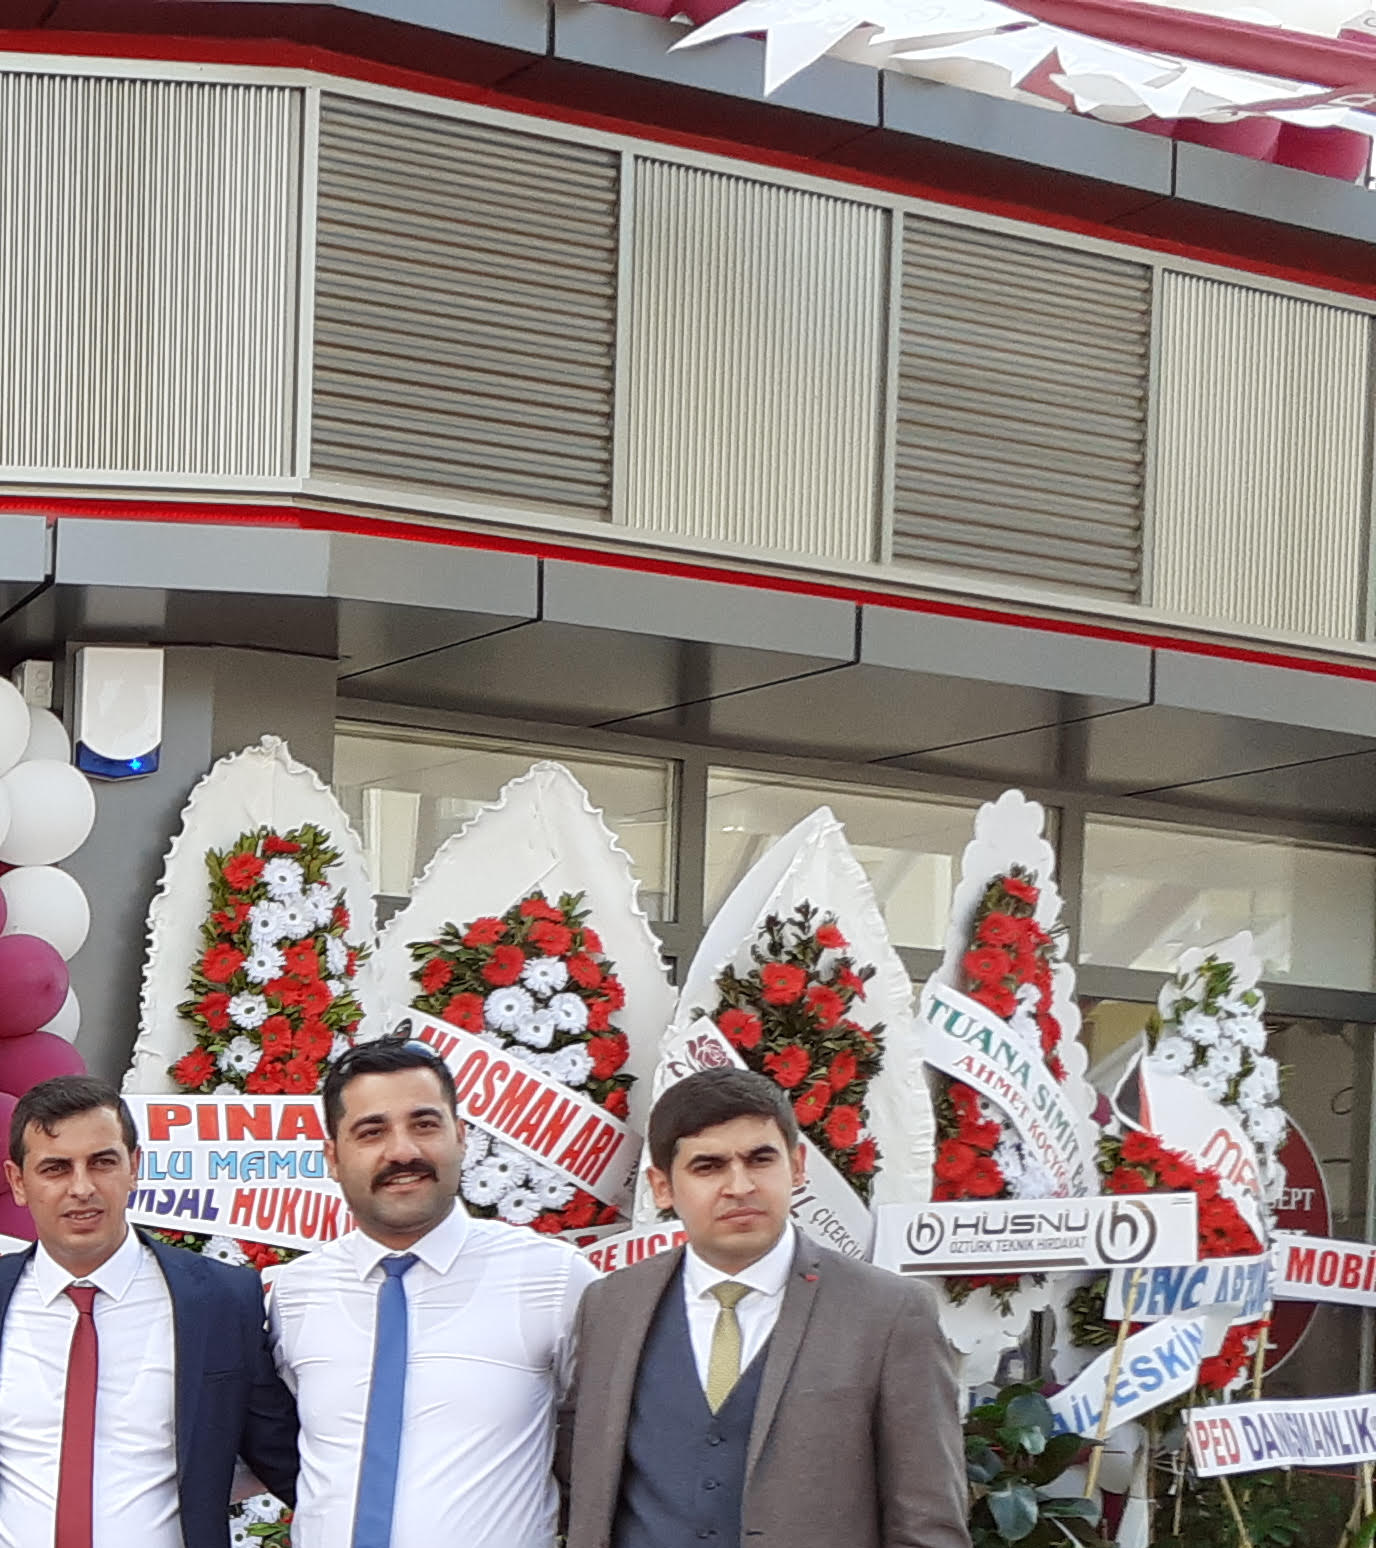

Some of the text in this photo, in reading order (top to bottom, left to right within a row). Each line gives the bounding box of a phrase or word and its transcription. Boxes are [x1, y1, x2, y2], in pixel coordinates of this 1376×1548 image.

[926, 993, 1033, 1090] TUANA
[952, 1055, 1030, 1118] AHMET
[454, 1050, 581, 1157] OSMAN
[556, 1113, 625, 1187] ARI
[209, 1150, 328, 1183] MAMU
[229, 1187, 342, 1242] HUKUK
[952, 1208, 1090, 1237] HÜSNÜ
[1113, 1322, 1205, 1407] ESKİN
